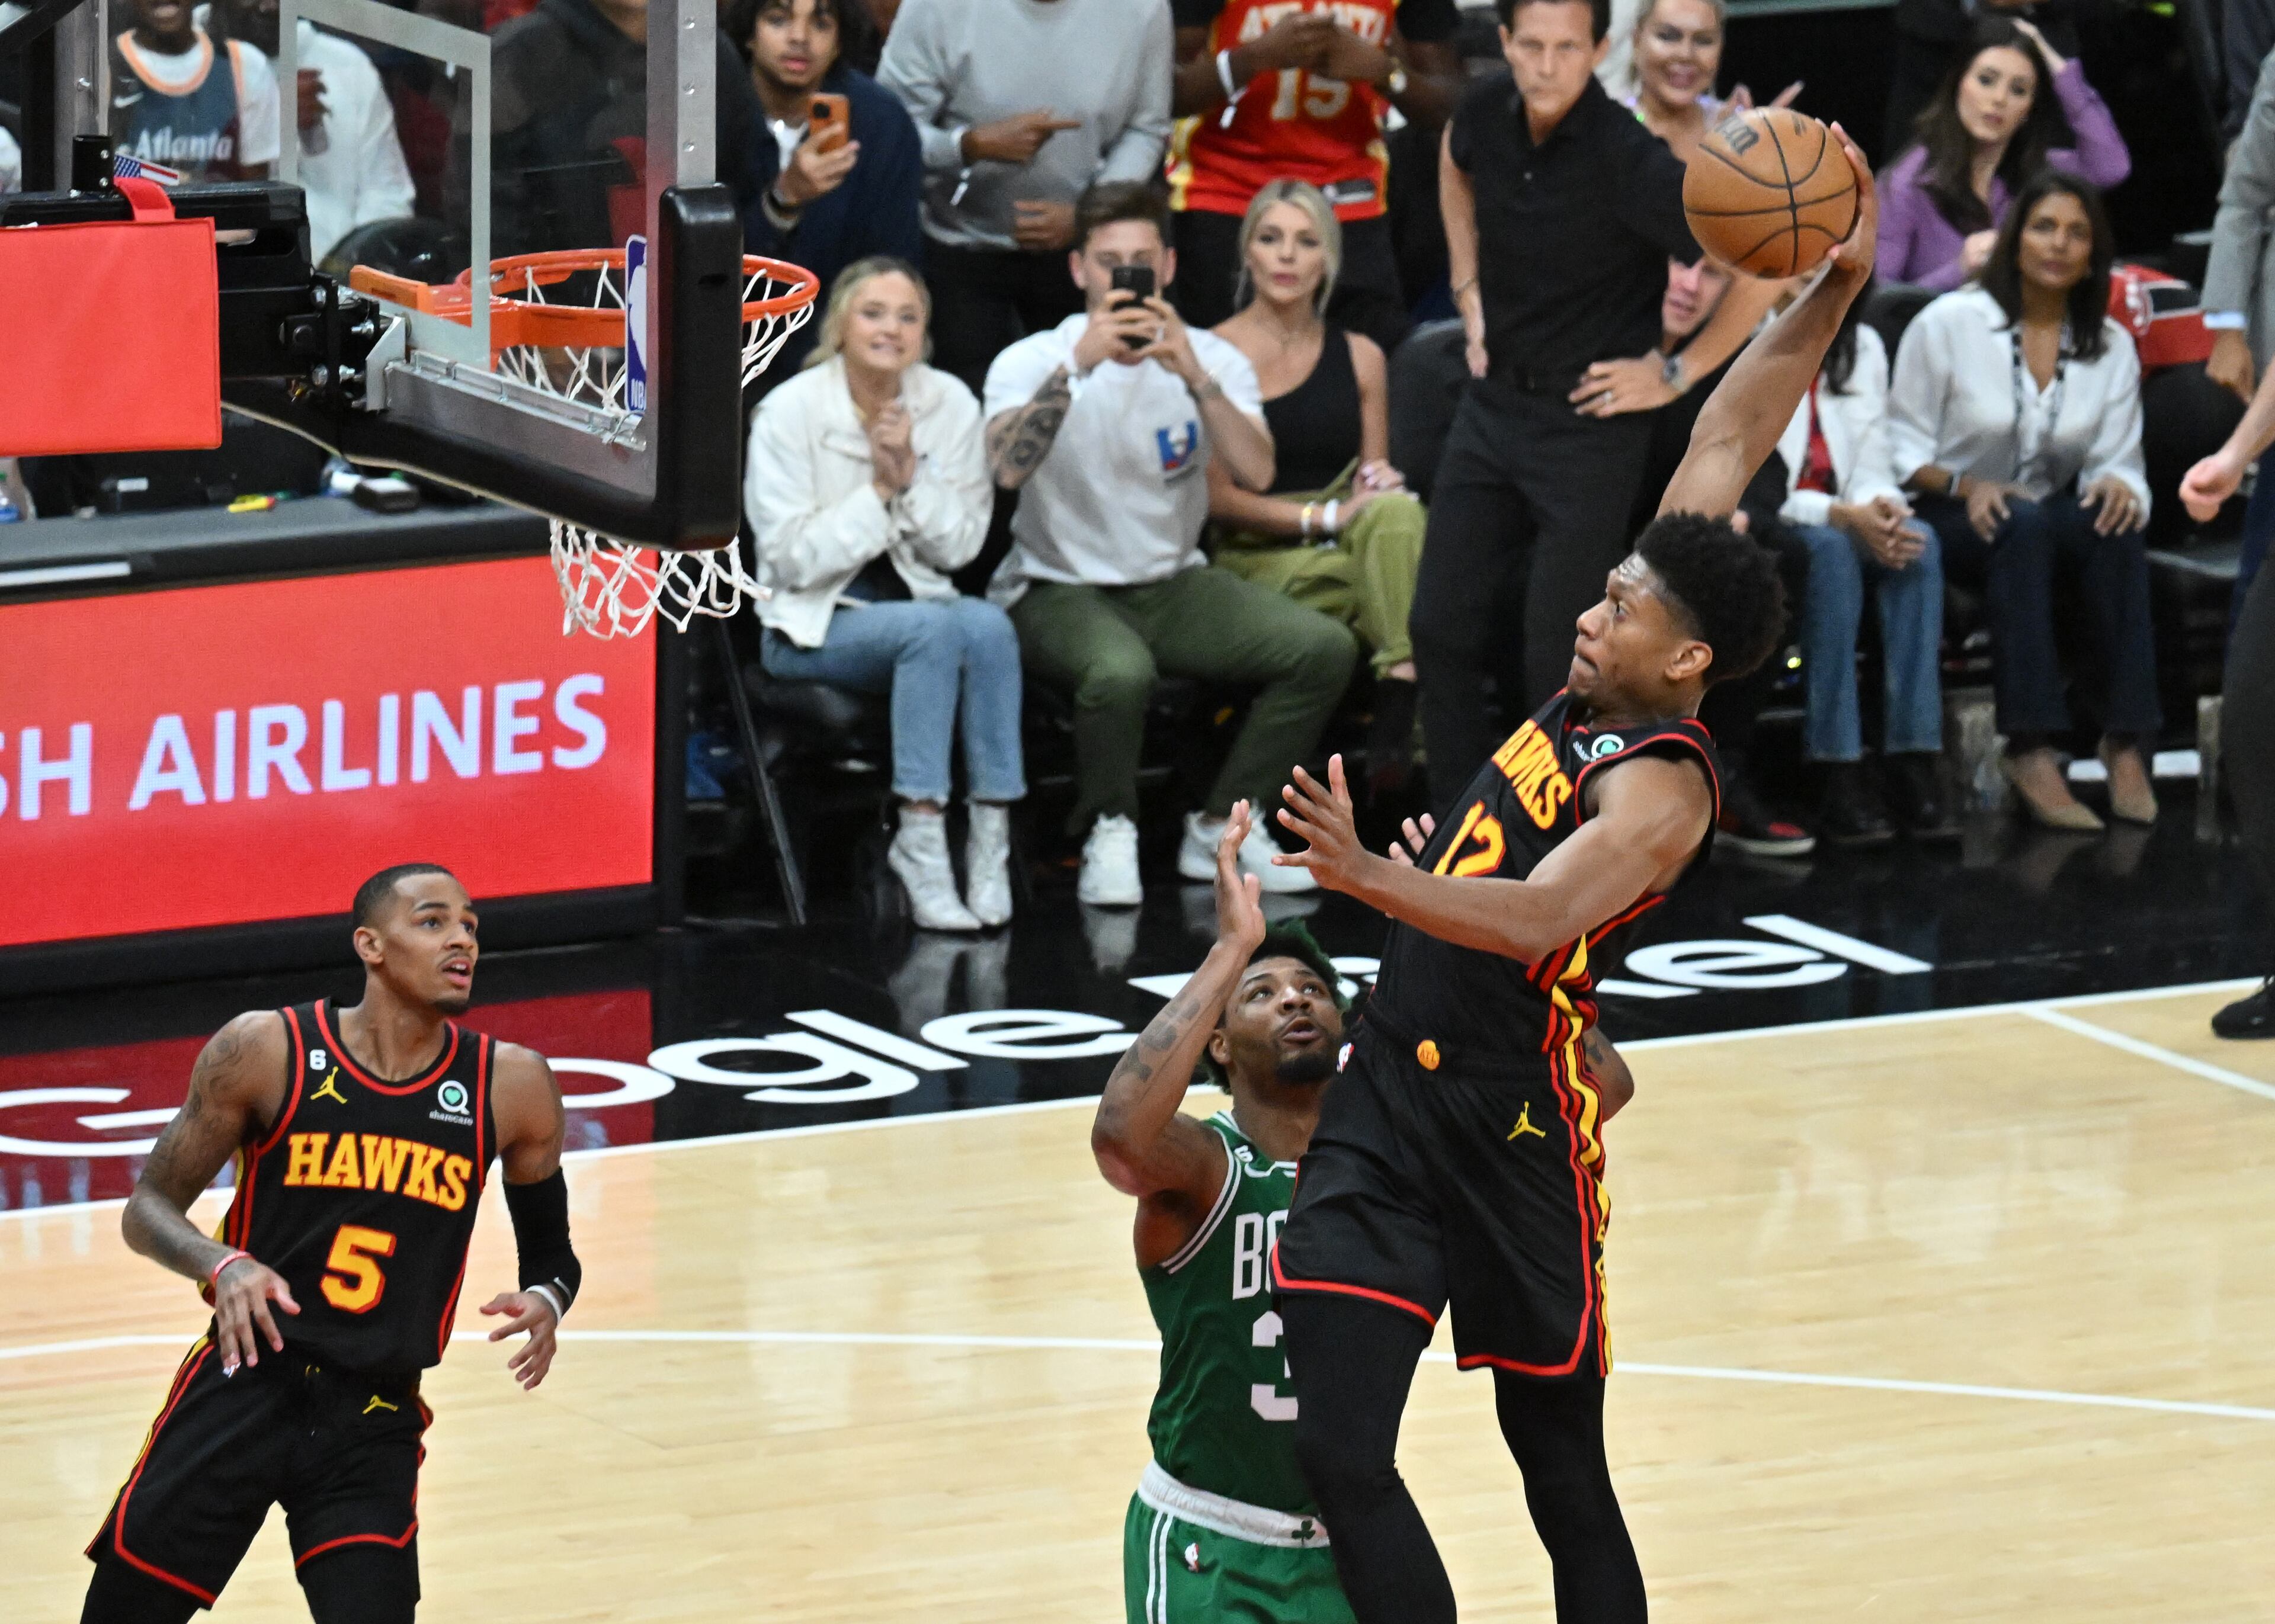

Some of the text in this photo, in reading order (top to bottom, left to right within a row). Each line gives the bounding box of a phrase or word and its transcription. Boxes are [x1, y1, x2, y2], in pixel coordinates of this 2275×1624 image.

[630, 377, 645, 409] NB
[0, 673, 607, 820] H AIRLINES
[1492, 718, 1574, 830] AWKS
[1433, 800, 1505, 877] 12
[0, 1009, 1140, 1158] Gogle
[310, 1049, 326, 1071] 6
[284, 1131, 473, 1212] HAWKS
[319, 1224, 397, 1314] 5
